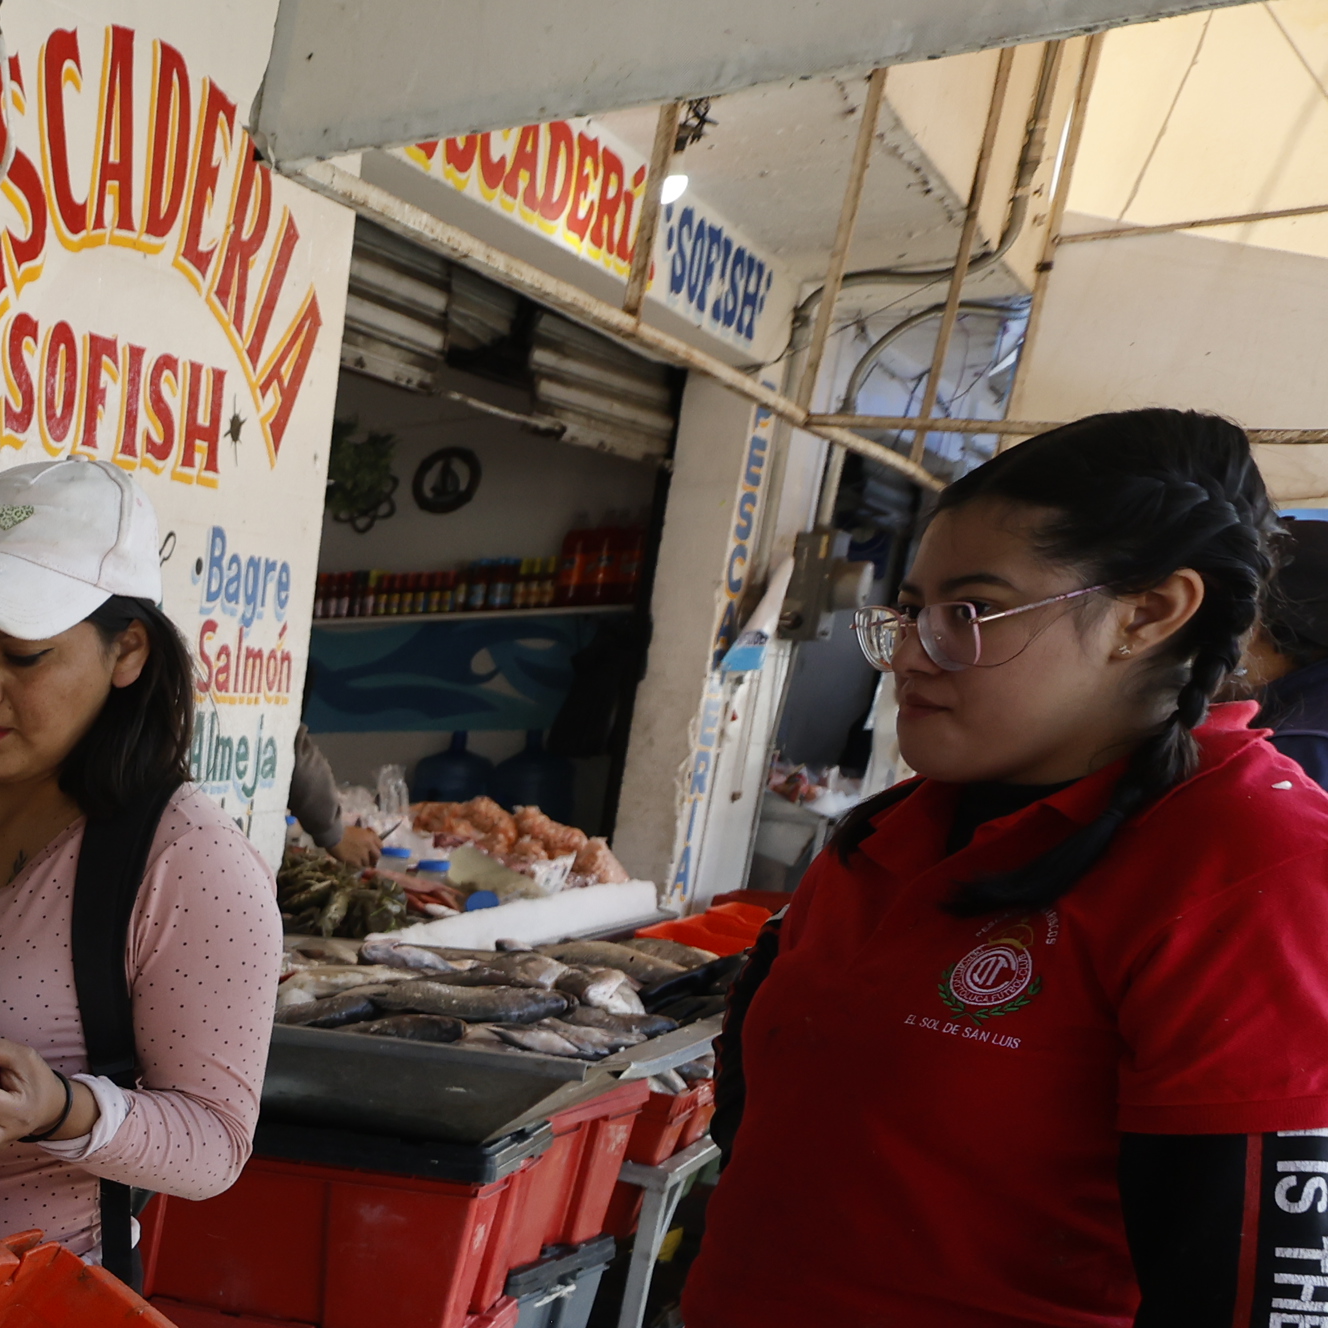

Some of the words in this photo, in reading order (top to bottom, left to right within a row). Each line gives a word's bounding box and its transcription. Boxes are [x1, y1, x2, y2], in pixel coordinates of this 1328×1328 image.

[0, 312, 227, 482] SOFISH
[205, 525, 291, 629] Bagre
[195, 619, 293, 695] Salmón
[904, 1014, 917, 1025] EL
[919, 1016, 940, 1031] SOL
[942, 1022, 962, 1035] DE
[961, 1026, 991, 1042] SAN
[991, 1033, 1022, 1049] LUIS
